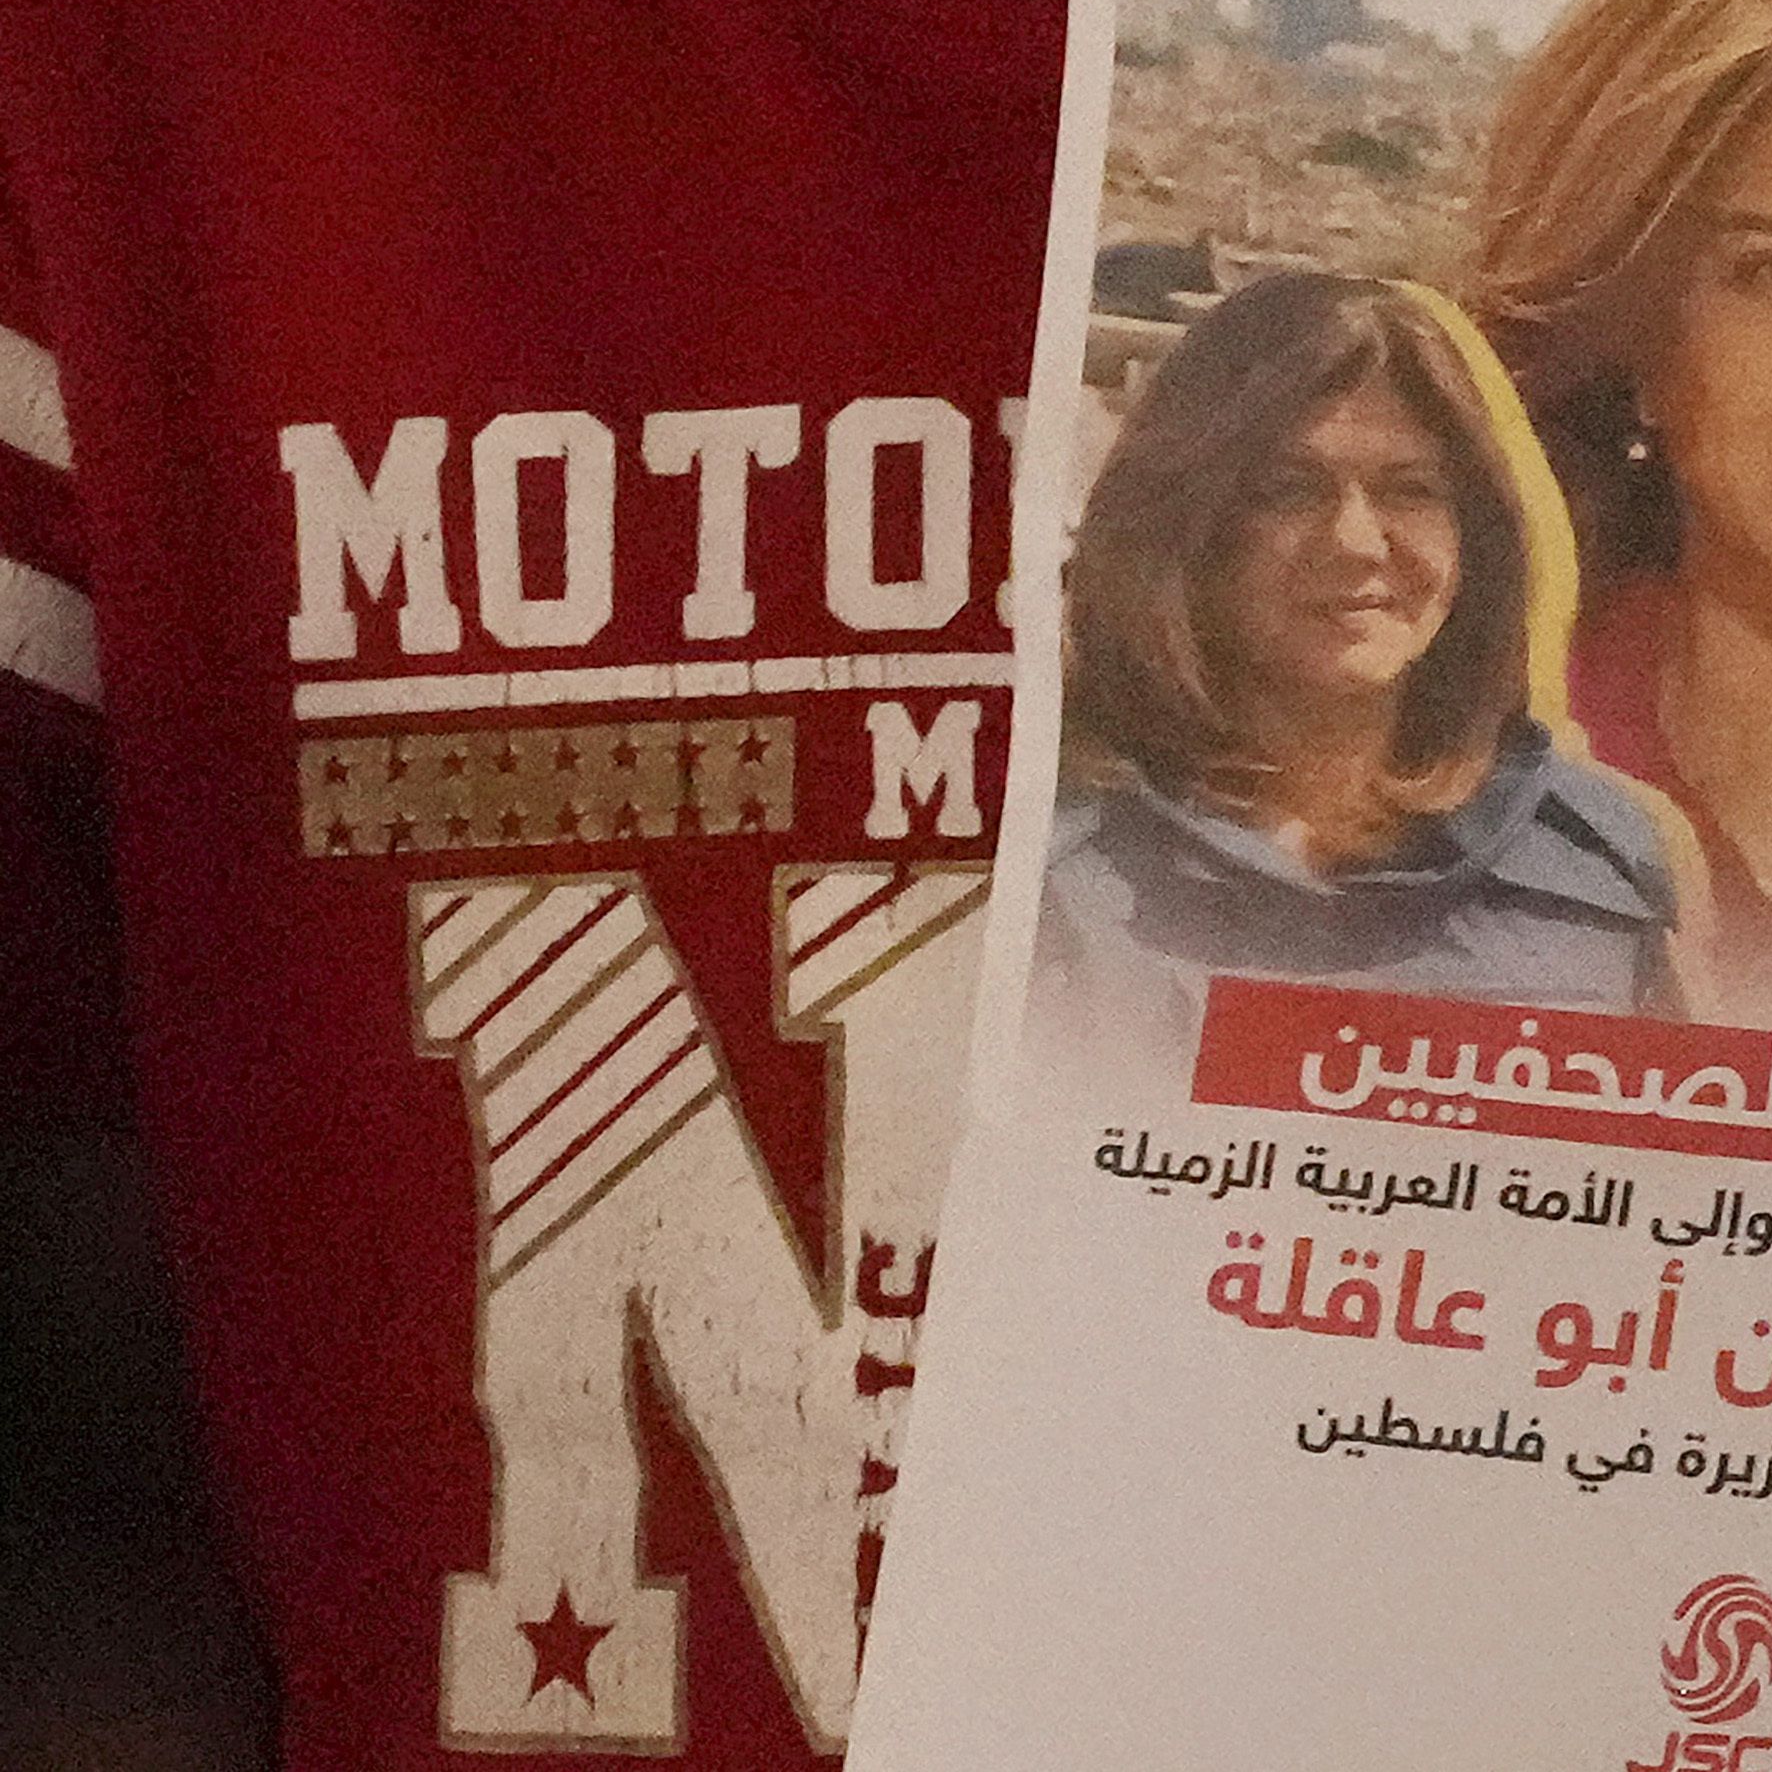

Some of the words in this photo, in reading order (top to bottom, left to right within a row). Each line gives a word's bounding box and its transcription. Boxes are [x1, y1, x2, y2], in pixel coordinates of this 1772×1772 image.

[280, 396, 1028, 660] MOTO
[1094, 1128, 1277, 1202] الزميلة
[1294, 1144, 1479, 1215] العربية
[1499, 1170, 1634, 1228] الأمة
[1205, 1230, 1487, 1351] عاقلة
[1534, 1258, 1685, 1394] أبو
[1297, 1397, 1546, 1461] فلسطين
[1566, 1429, 1655, 1492] في
